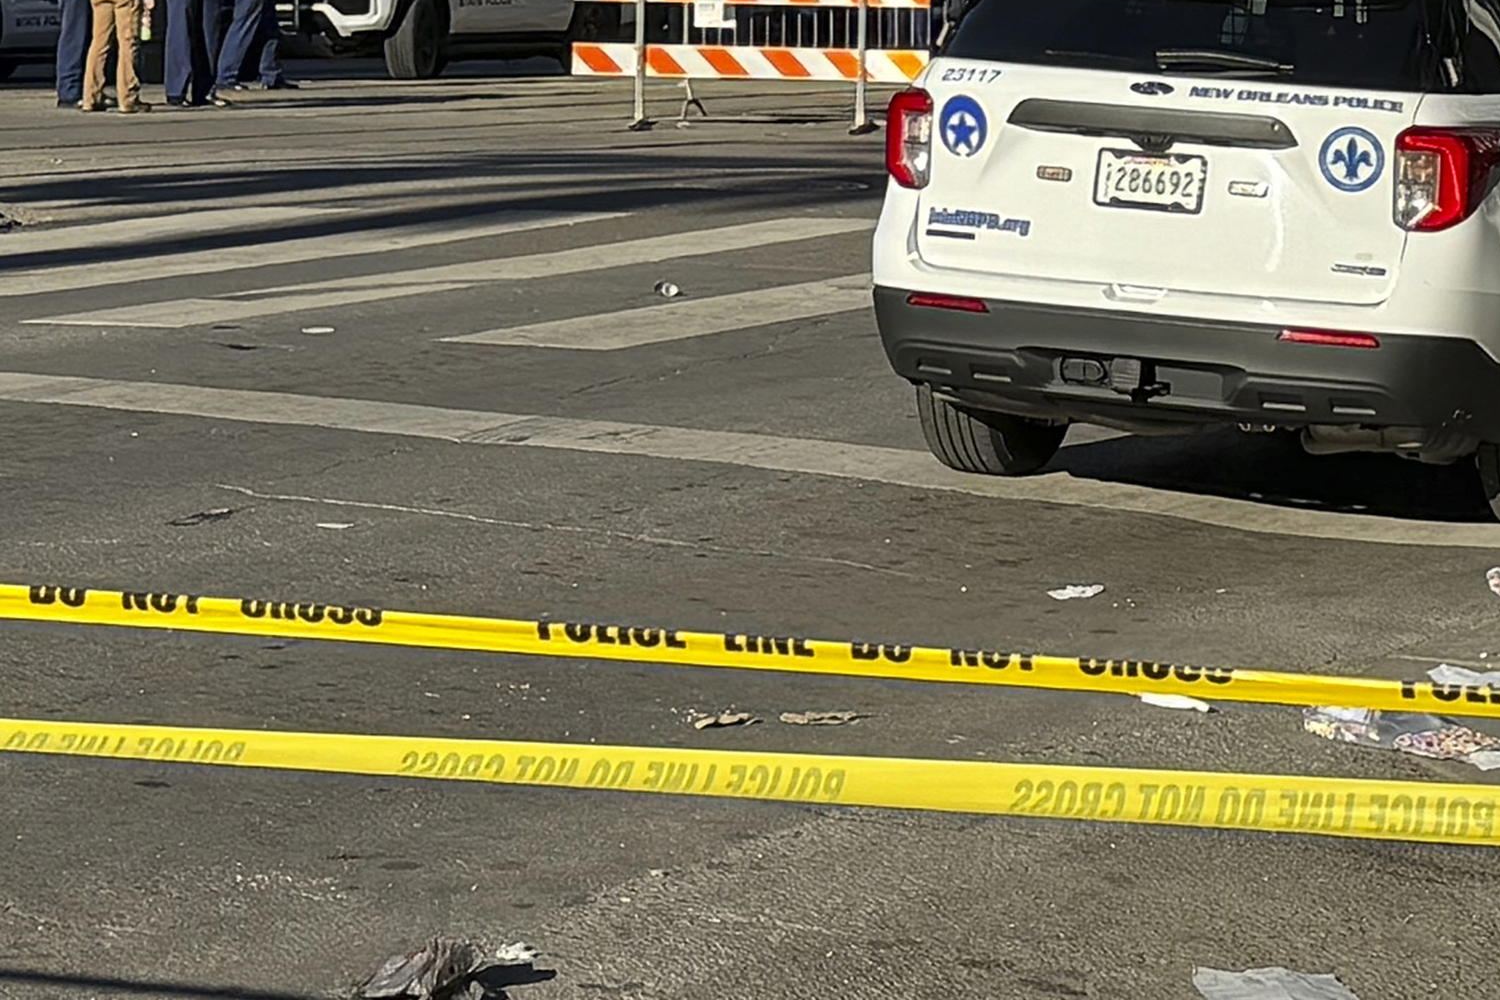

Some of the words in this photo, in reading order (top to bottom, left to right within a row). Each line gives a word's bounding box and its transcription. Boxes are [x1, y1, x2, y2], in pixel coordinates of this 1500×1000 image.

[942, 67, 1002, 84] 23117
[1189, 85, 1234, 99] NEW
[1236, 88, 1330, 107] ORLEANS
[1332, 94, 1405, 114] POLICE
[1114, 165, 1196, 199] 286692
